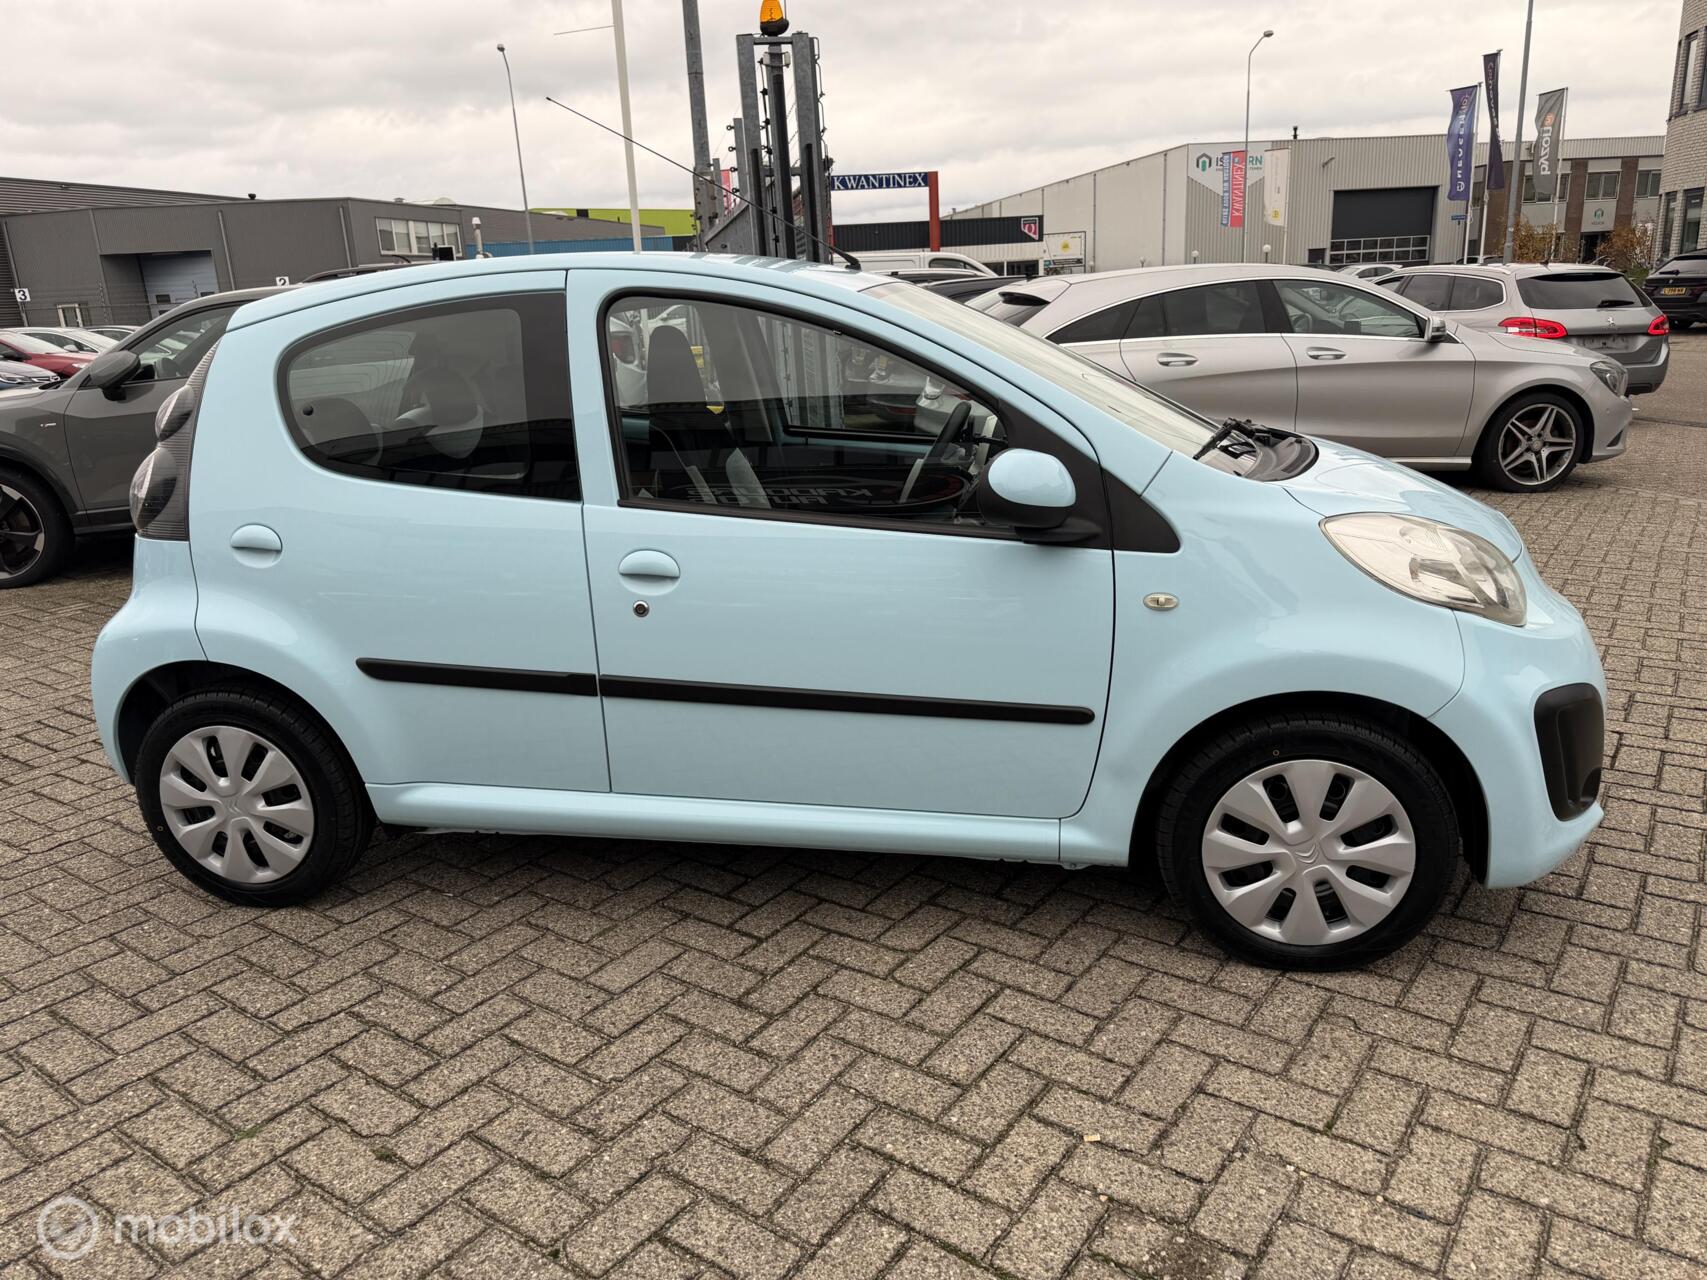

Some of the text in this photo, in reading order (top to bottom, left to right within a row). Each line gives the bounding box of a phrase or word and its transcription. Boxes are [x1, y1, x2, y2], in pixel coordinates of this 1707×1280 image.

[833, 173, 925, 190] KWANTINEX
[278, 277, 287, 286] 2
[17, 289, 28, 301] 3
